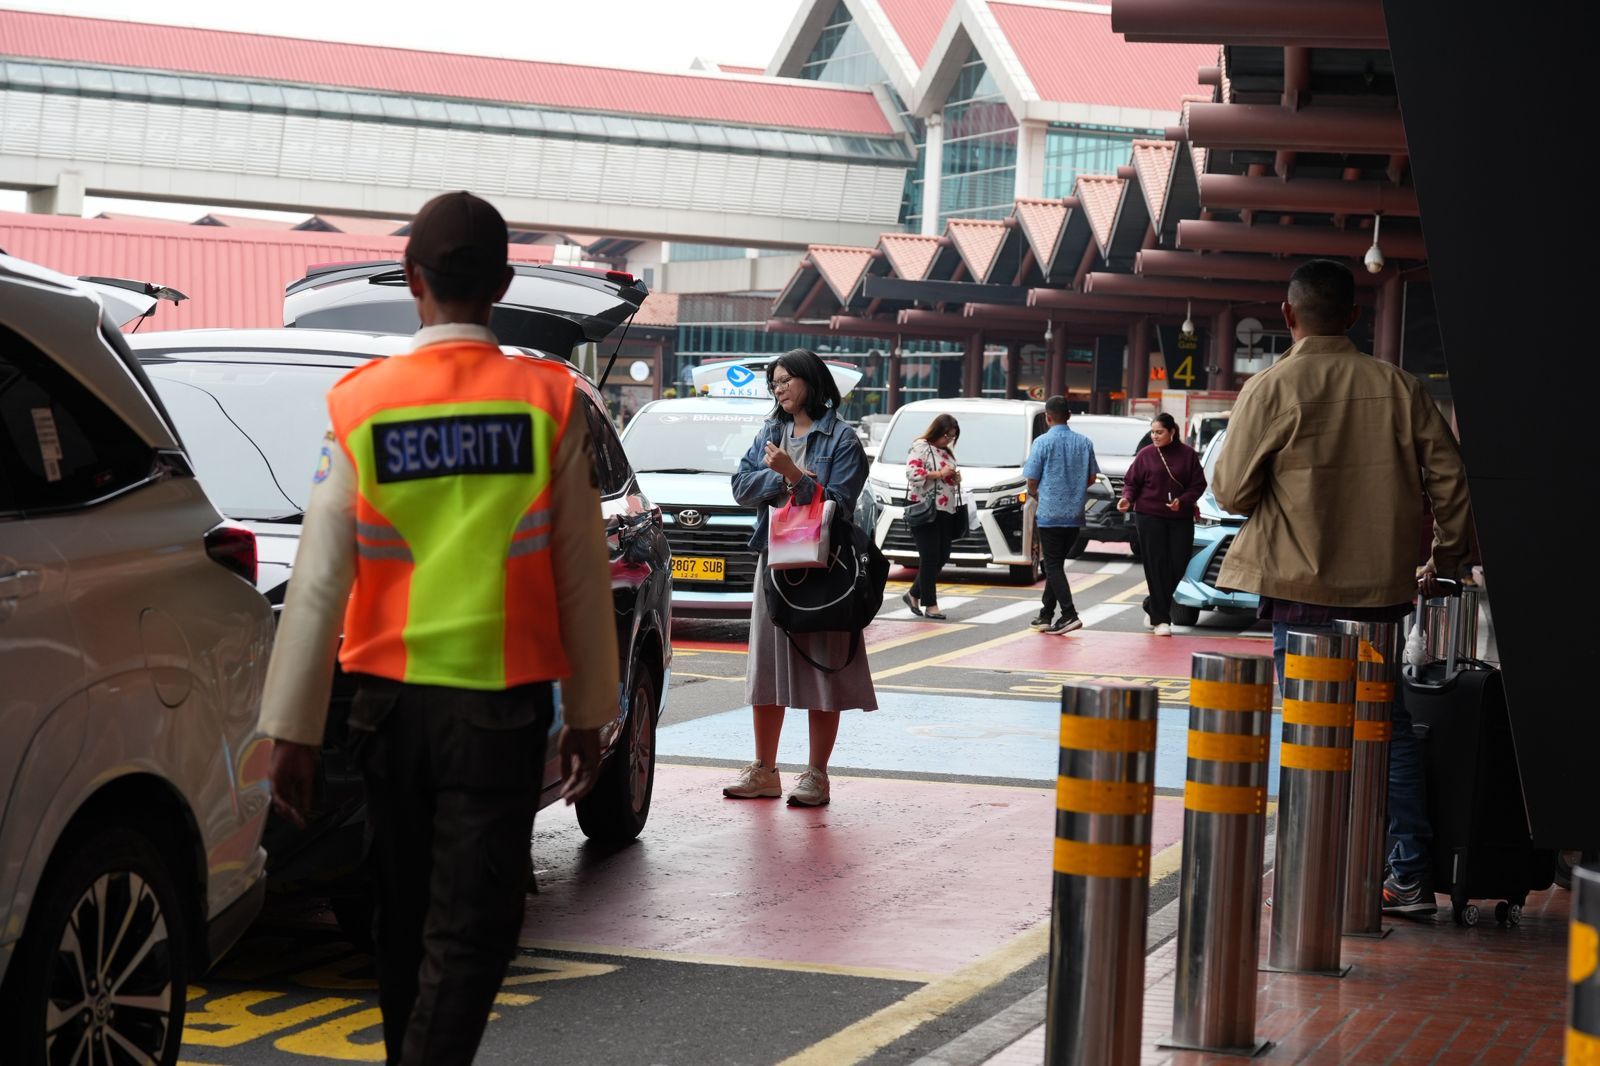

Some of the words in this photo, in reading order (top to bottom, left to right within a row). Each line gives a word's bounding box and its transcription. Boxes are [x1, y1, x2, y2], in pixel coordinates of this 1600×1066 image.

[1178, 341, 1197, 349] Gate
[1173, 355, 1196, 387] 4
[722, 388, 758, 396] TAKSI
[692, 414, 754, 423] Bluebird
[385, 423, 524, 474] SECURITY
[703, 561, 722, 573] SUB
